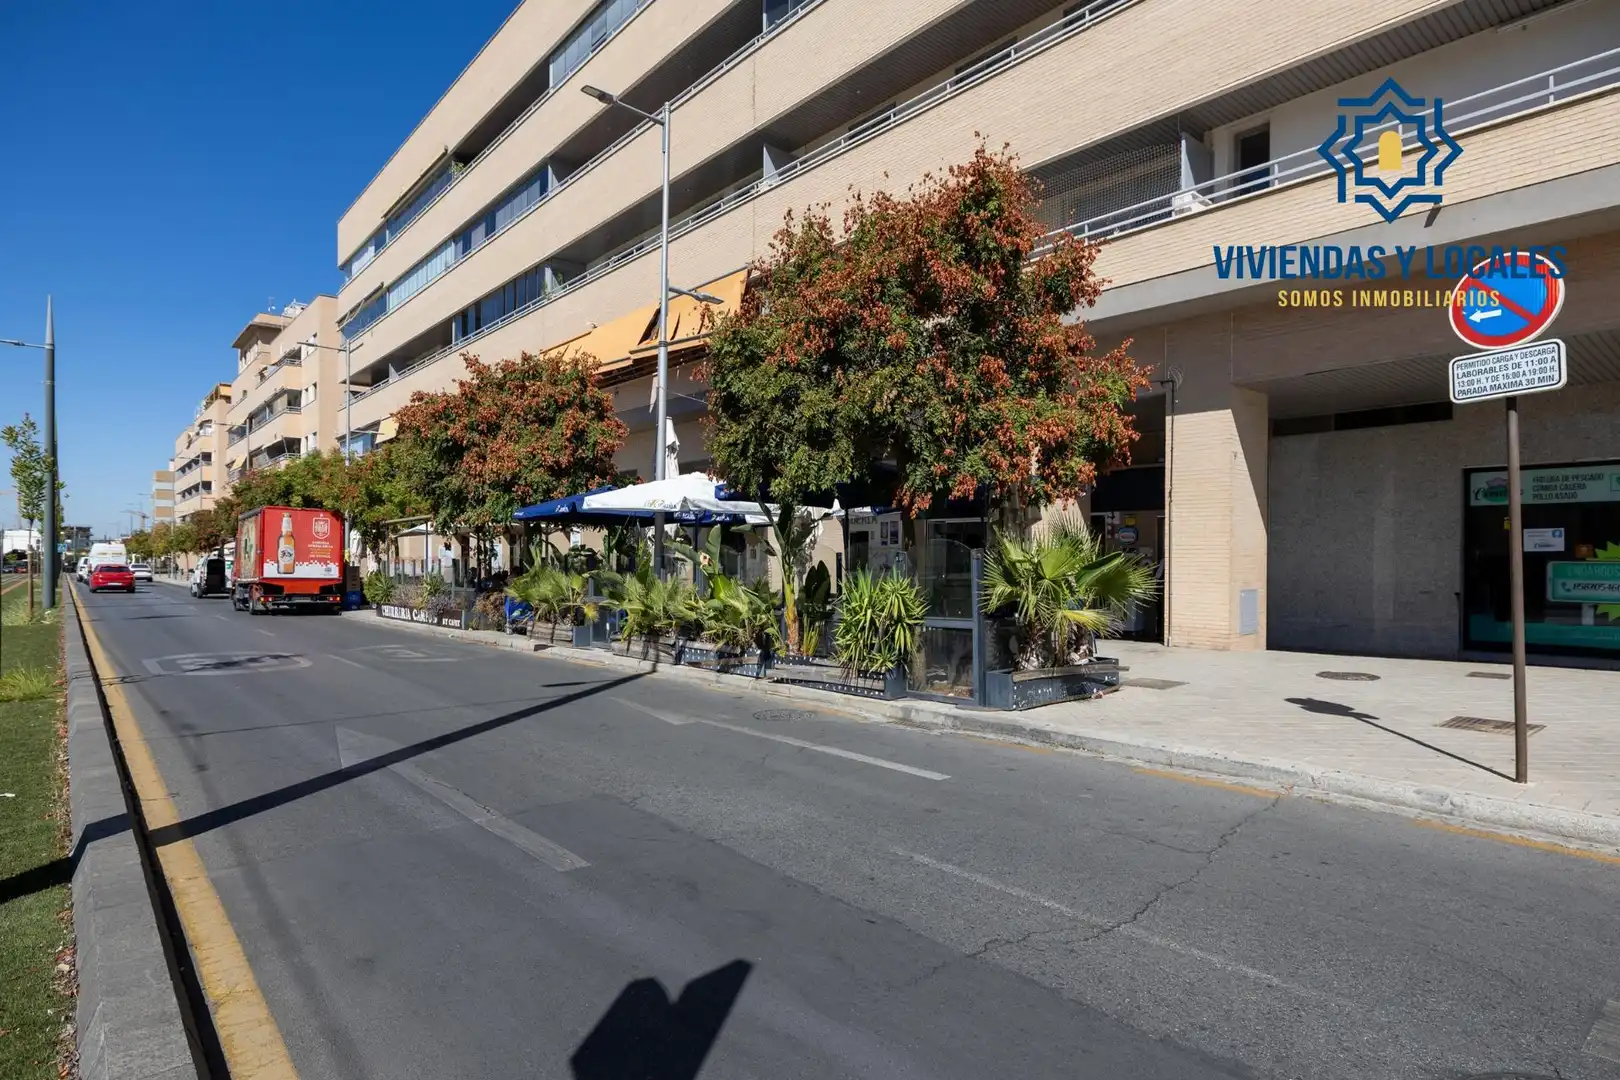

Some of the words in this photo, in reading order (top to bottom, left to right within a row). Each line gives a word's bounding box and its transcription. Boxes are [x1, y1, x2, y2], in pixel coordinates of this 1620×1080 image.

[1456, 358, 1491, 371] PERMITIDO
[1492, 354, 1513, 365] CARGA
[1514, 352, 1520, 360] Y
[1520, 346, 1556, 359] DESCARGA
[1456, 364, 1509, 379] LABORABLES
[1512, 361, 1522, 370] DE
[1525, 357, 1548, 368] 11:00
[1550, 355, 1557, 363] A
[1457, 379, 1475, 388] 13:00
[1485, 375, 1490, 383] Y
[1491, 374, 1500, 382] DE
[1528, 367, 1547, 376] 19:00
[1457, 386, 1488, 397] PARADA
[1489, 381, 1523, 392] MAXIMA
[1525, 378, 1535, 386] 30
[1537, 374, 1557, 384] MIN.
[1532, 492, 1553, 501] POLLO
